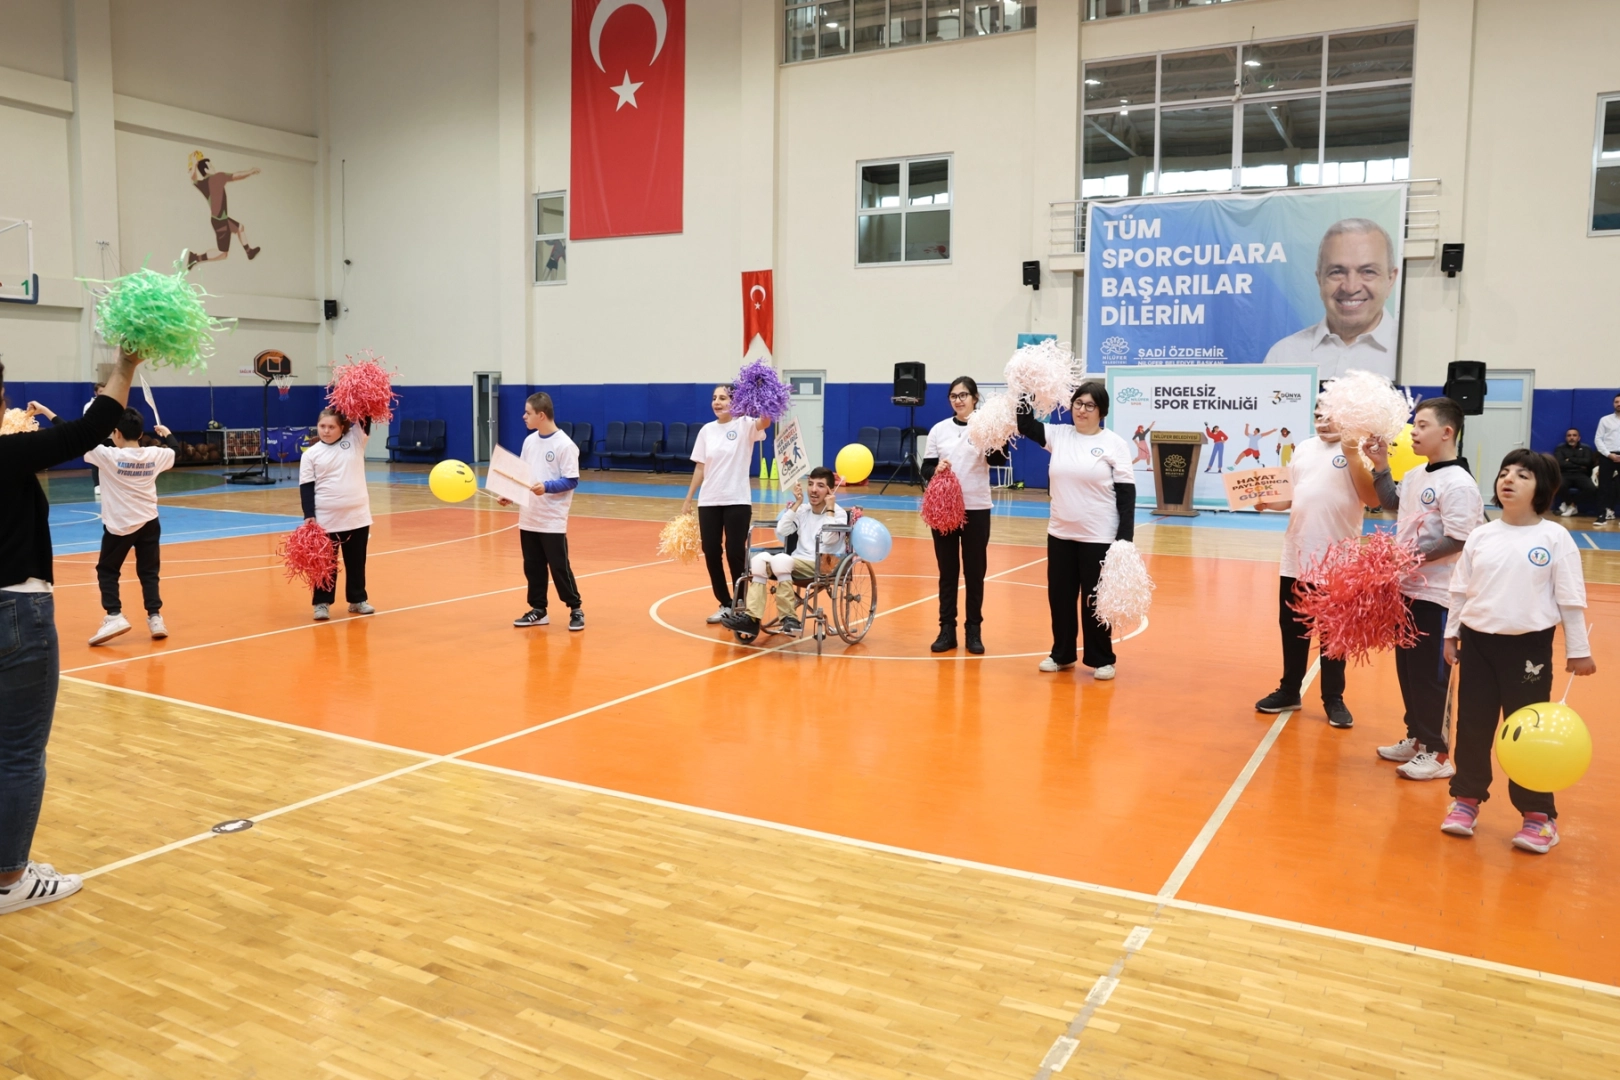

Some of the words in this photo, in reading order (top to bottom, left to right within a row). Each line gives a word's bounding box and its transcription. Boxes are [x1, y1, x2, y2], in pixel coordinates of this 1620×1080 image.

[1103, 214, 1161, 240] TÜM
[1102, 242, 1287, 269] SPORCULARA
[21, 279, 29, 295] 1
[1101, 273, 1252, 302] BAŞARILAR
[1101, 299, 1205, 326] DİLERİM
[1138, 345, 1166, 359] ŞADİ
[1168, 345, 1224, 357] ÖZDEMİR
[1154, 384, 1216, 397] ENGELSİZ
[1154, 399, 1189, 410] SPOR
[1193, 396, 1257, 410] ETKİNLİĞİ
[1237, 474, 1276, 485] HAYAT
[1239, 490, 1281, 501] GÜZEL
